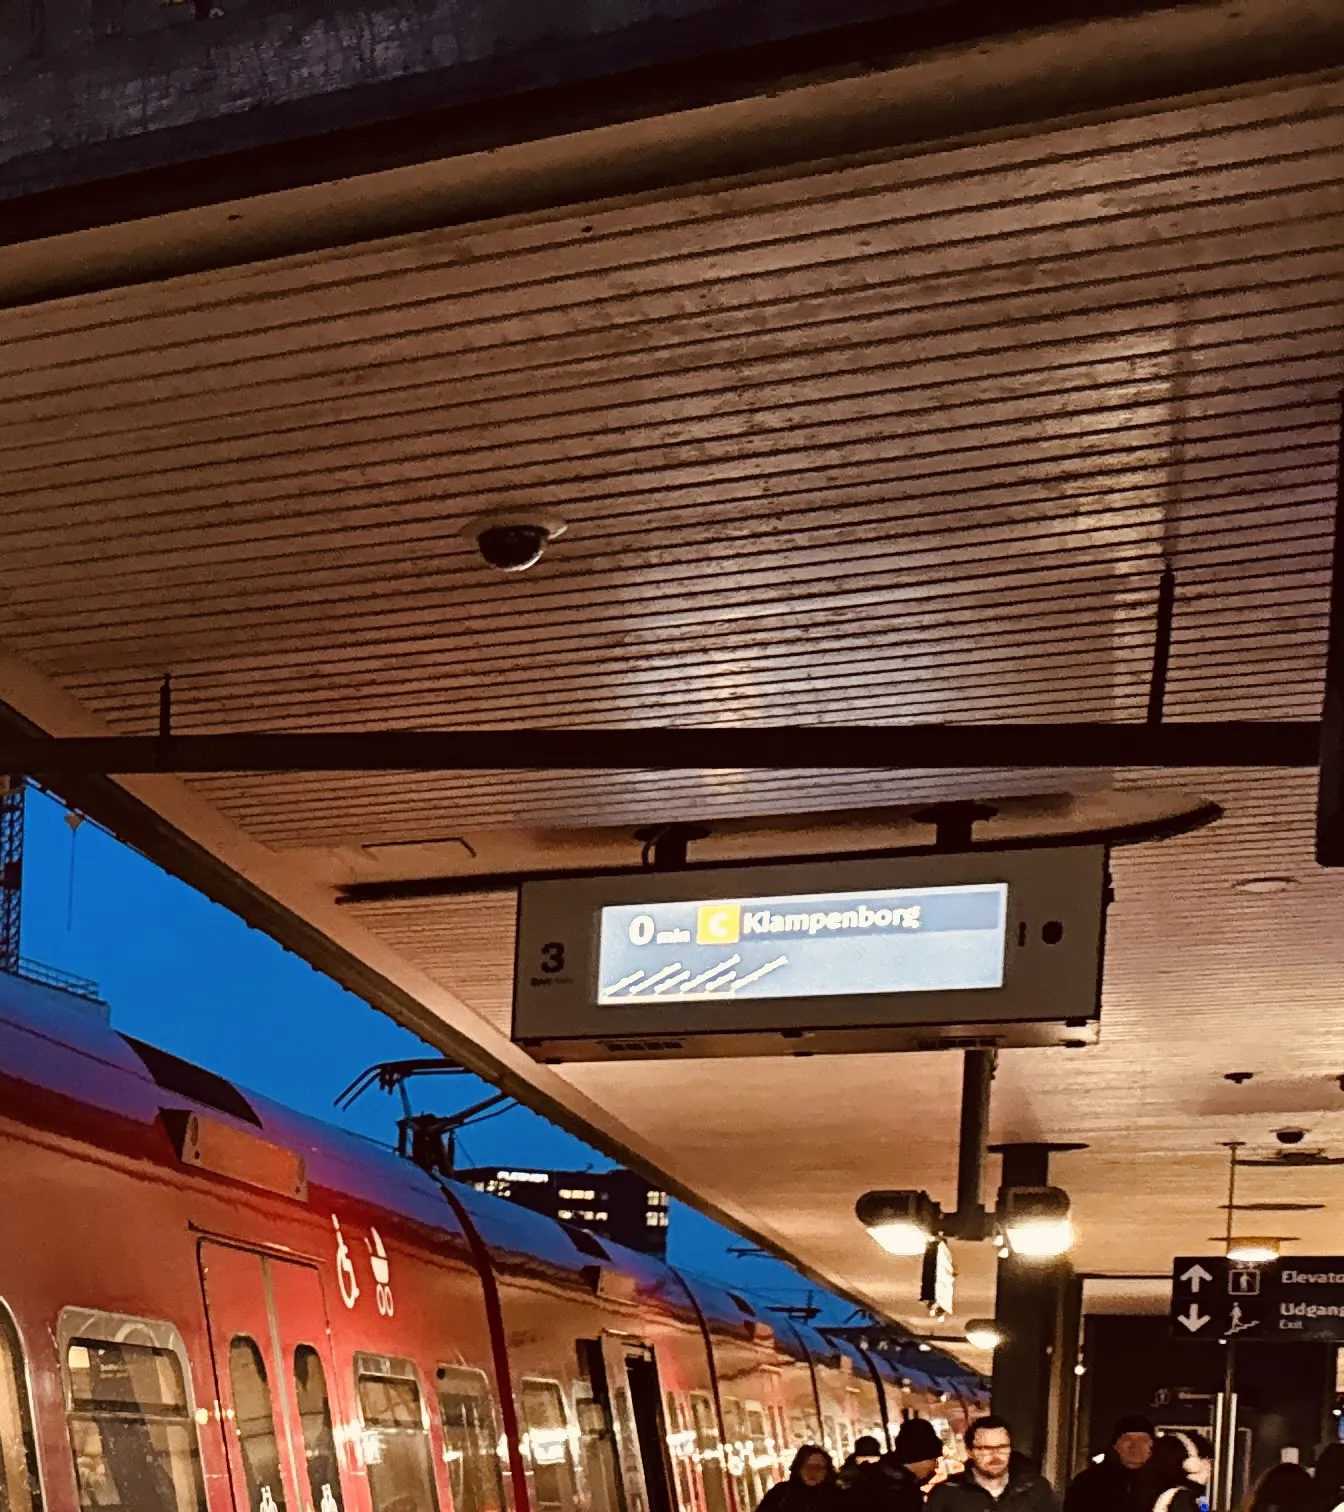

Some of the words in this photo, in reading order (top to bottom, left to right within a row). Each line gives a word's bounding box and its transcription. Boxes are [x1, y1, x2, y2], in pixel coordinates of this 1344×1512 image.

[629, 915, 654, 946] 0
[656, 928, 691, 945] min
[708, 911, 728, 937] C
[744, 905, 920, 935] Klampenborg
[540, 942, 566, 974] 3
